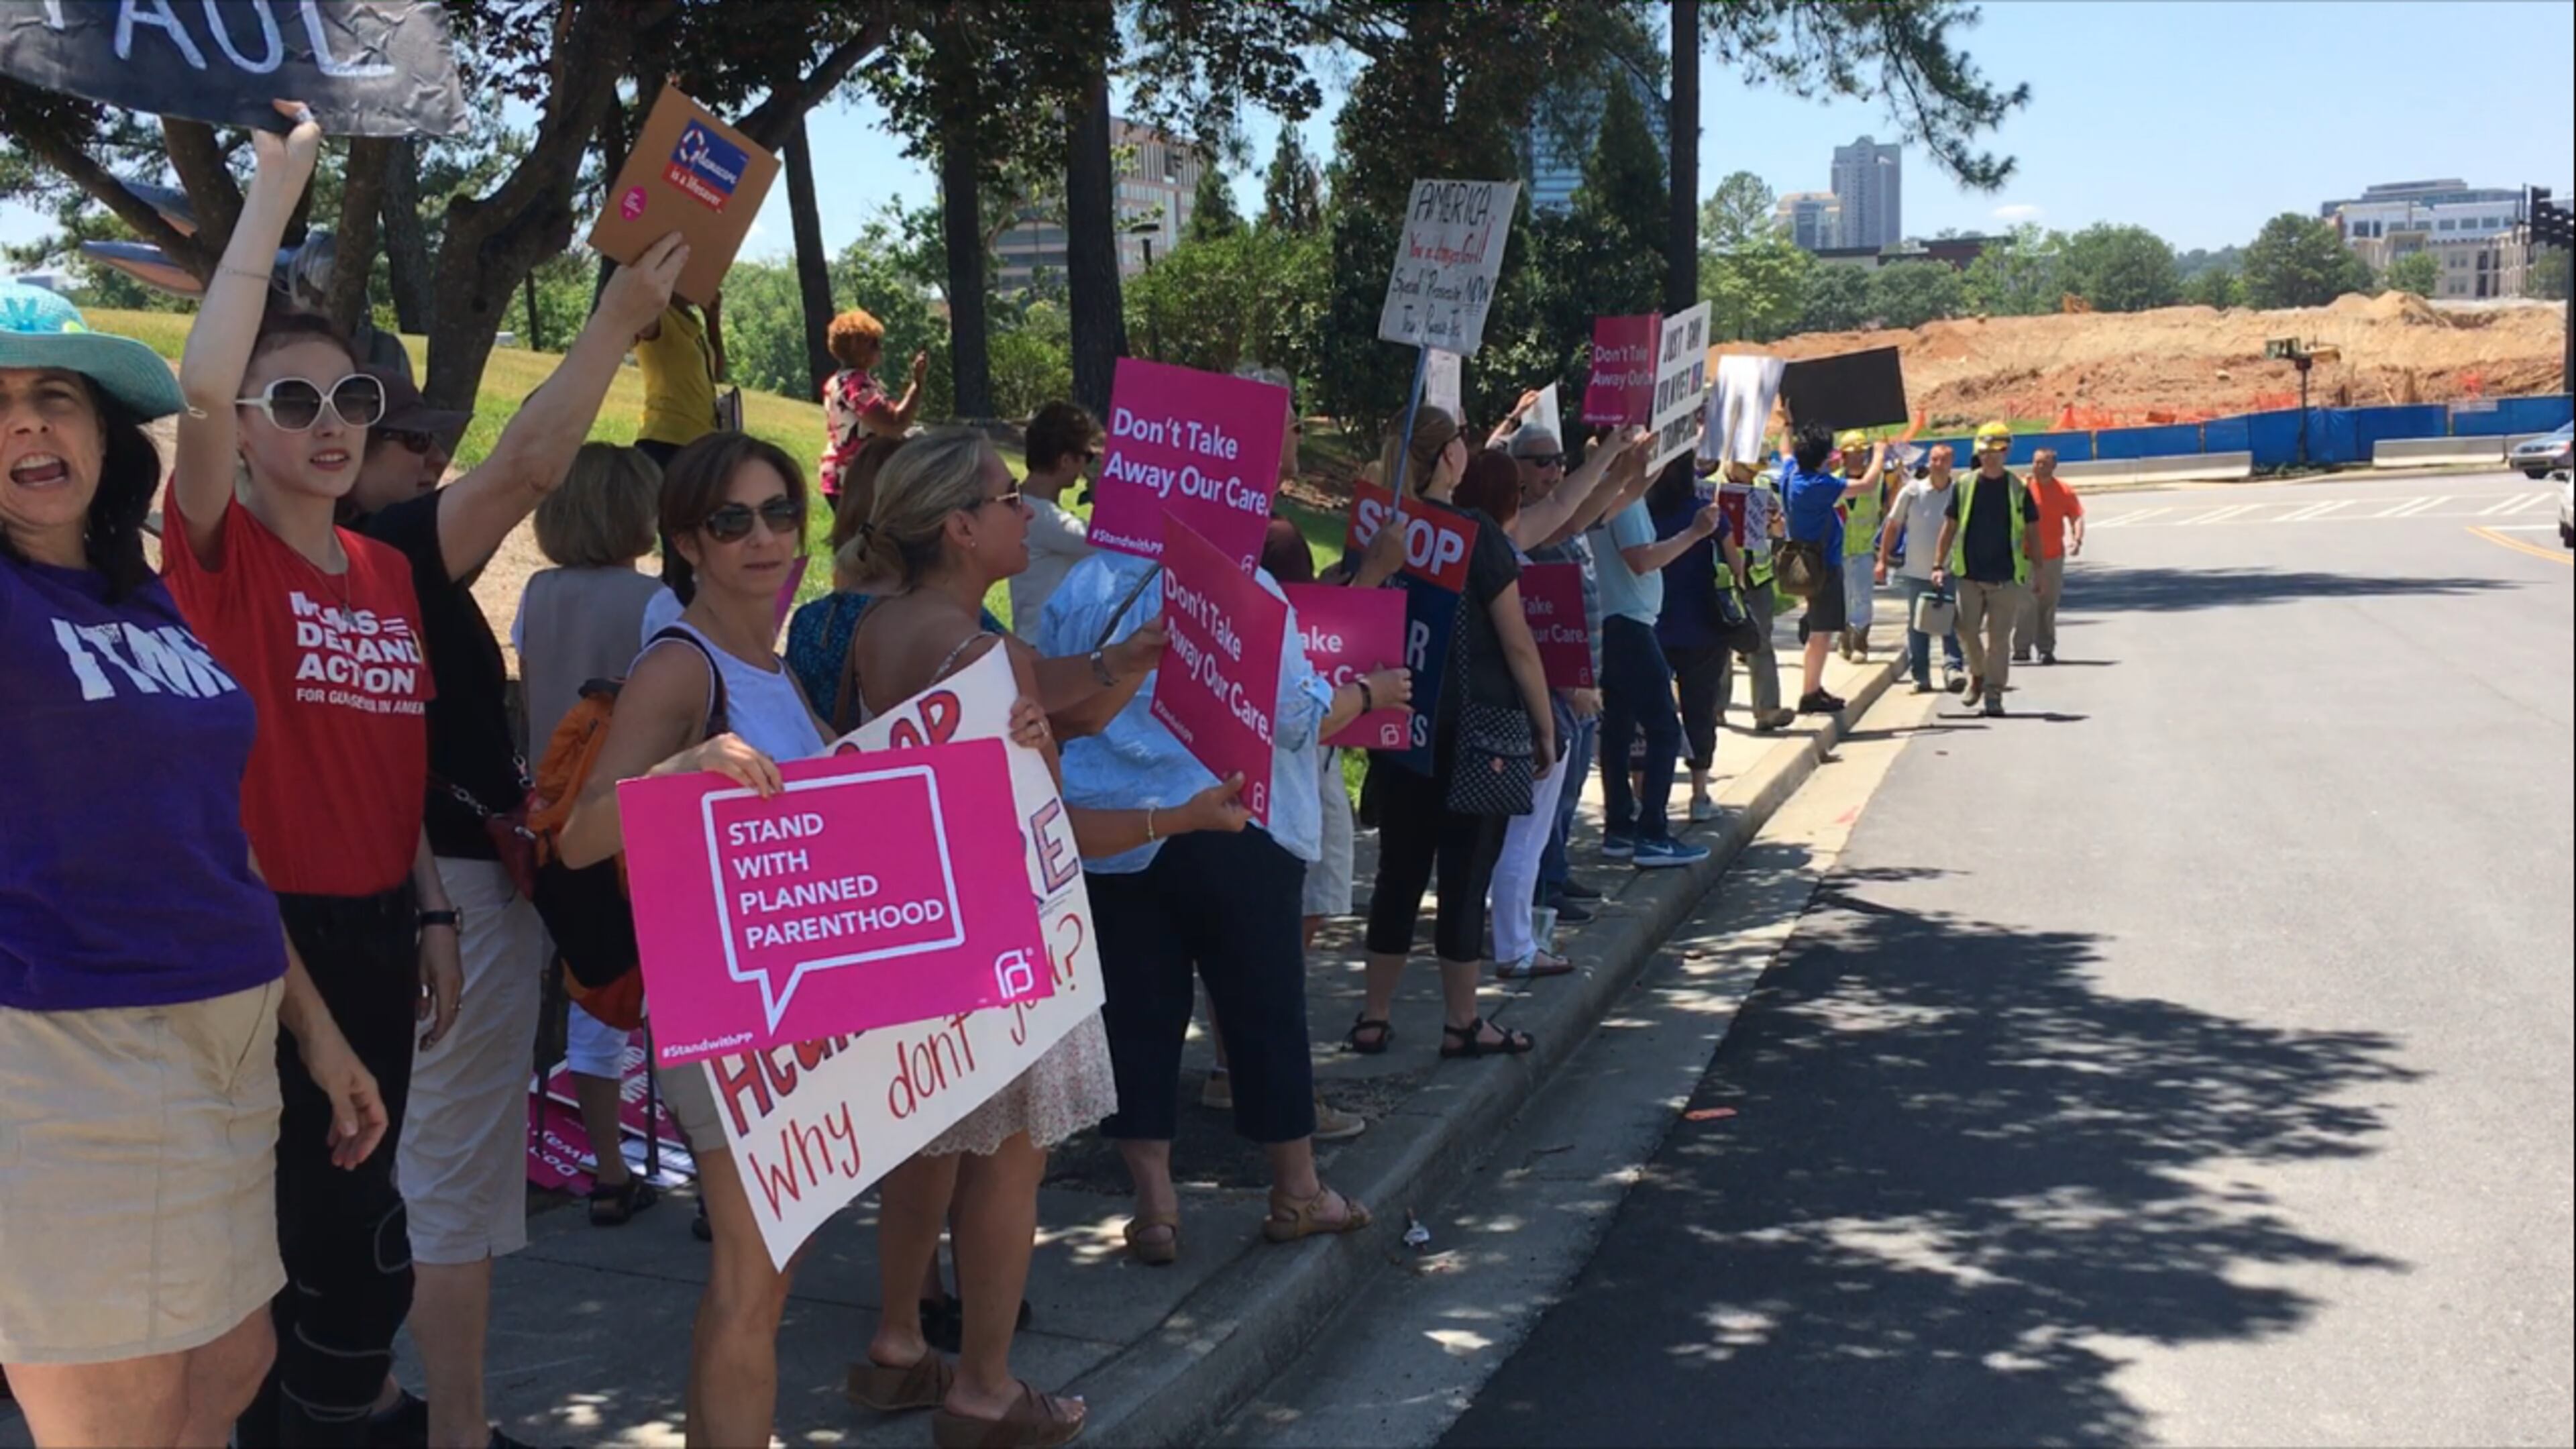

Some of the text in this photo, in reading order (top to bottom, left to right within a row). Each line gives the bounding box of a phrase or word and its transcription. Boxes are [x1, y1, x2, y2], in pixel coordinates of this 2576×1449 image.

[42, 0, 396, 76] AUL
[1112, 408, 1238, 460] Don't Take
[1104, 451, 1270, 517] Away Our Care.
[289, 590, 380, 635] MMS
[1165, 567, 1241, 661] Don't Take
[1297, 625, 1342, 653] ake
[295, 652, 415, 694] ACTON
[296, 687, 325, 702] FOR
[1164, 616, 1273, 745] Away Our Care.
[729, 812, 824, 846] STAND
[732, 849, 810, 880] WITH
[739, 874, 879, 915] PLANNED
[745, 899, 945, 950] PARENTHOOD
[661, 1030, 754, 1059] #StandwithPP
[747, 1100, 861, 1222] Why
